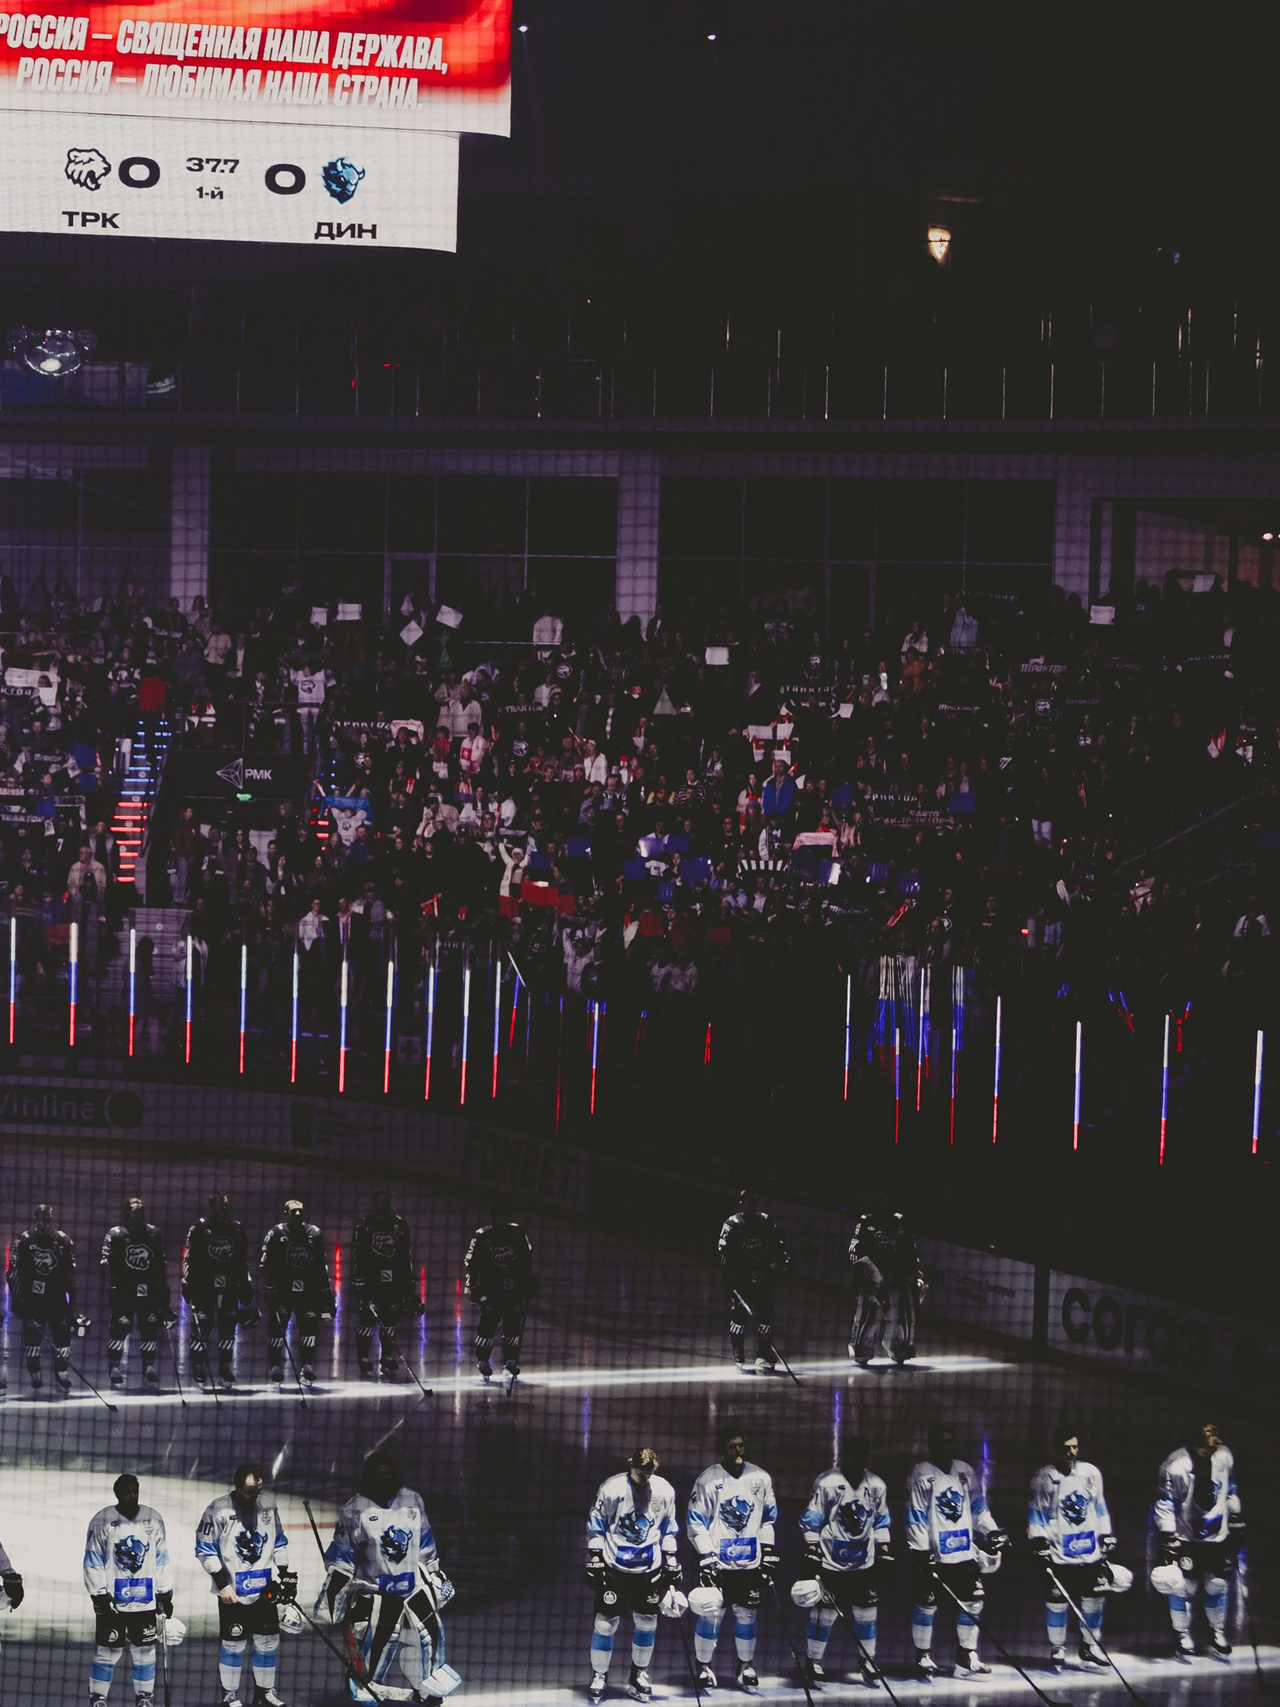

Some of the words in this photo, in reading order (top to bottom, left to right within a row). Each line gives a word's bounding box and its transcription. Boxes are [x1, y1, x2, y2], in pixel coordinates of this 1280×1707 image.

[116, 19, 263, 61] СВЯЩЕННАЯ
[262, 28, 330, 64] НАША
[332, 32, 448, 75] ДЕРЖАВА,
[16, 57, 113, 94] РОССИЯ
[140, 63, 262, 102] ЛЮБИМАЯ
[262, 70, 330, 106] НАША
[118, 156, 161, 189] 0
[186, 157, 240, 174] 37.7
[264, 163, 306, 195] 0
[196, 185, 224, 200] 1-й
[62, 210, 120, 229] ТРК
[314, 221, 378, 240] ДИН
[461, 1129, 580, 1201] FONBET
